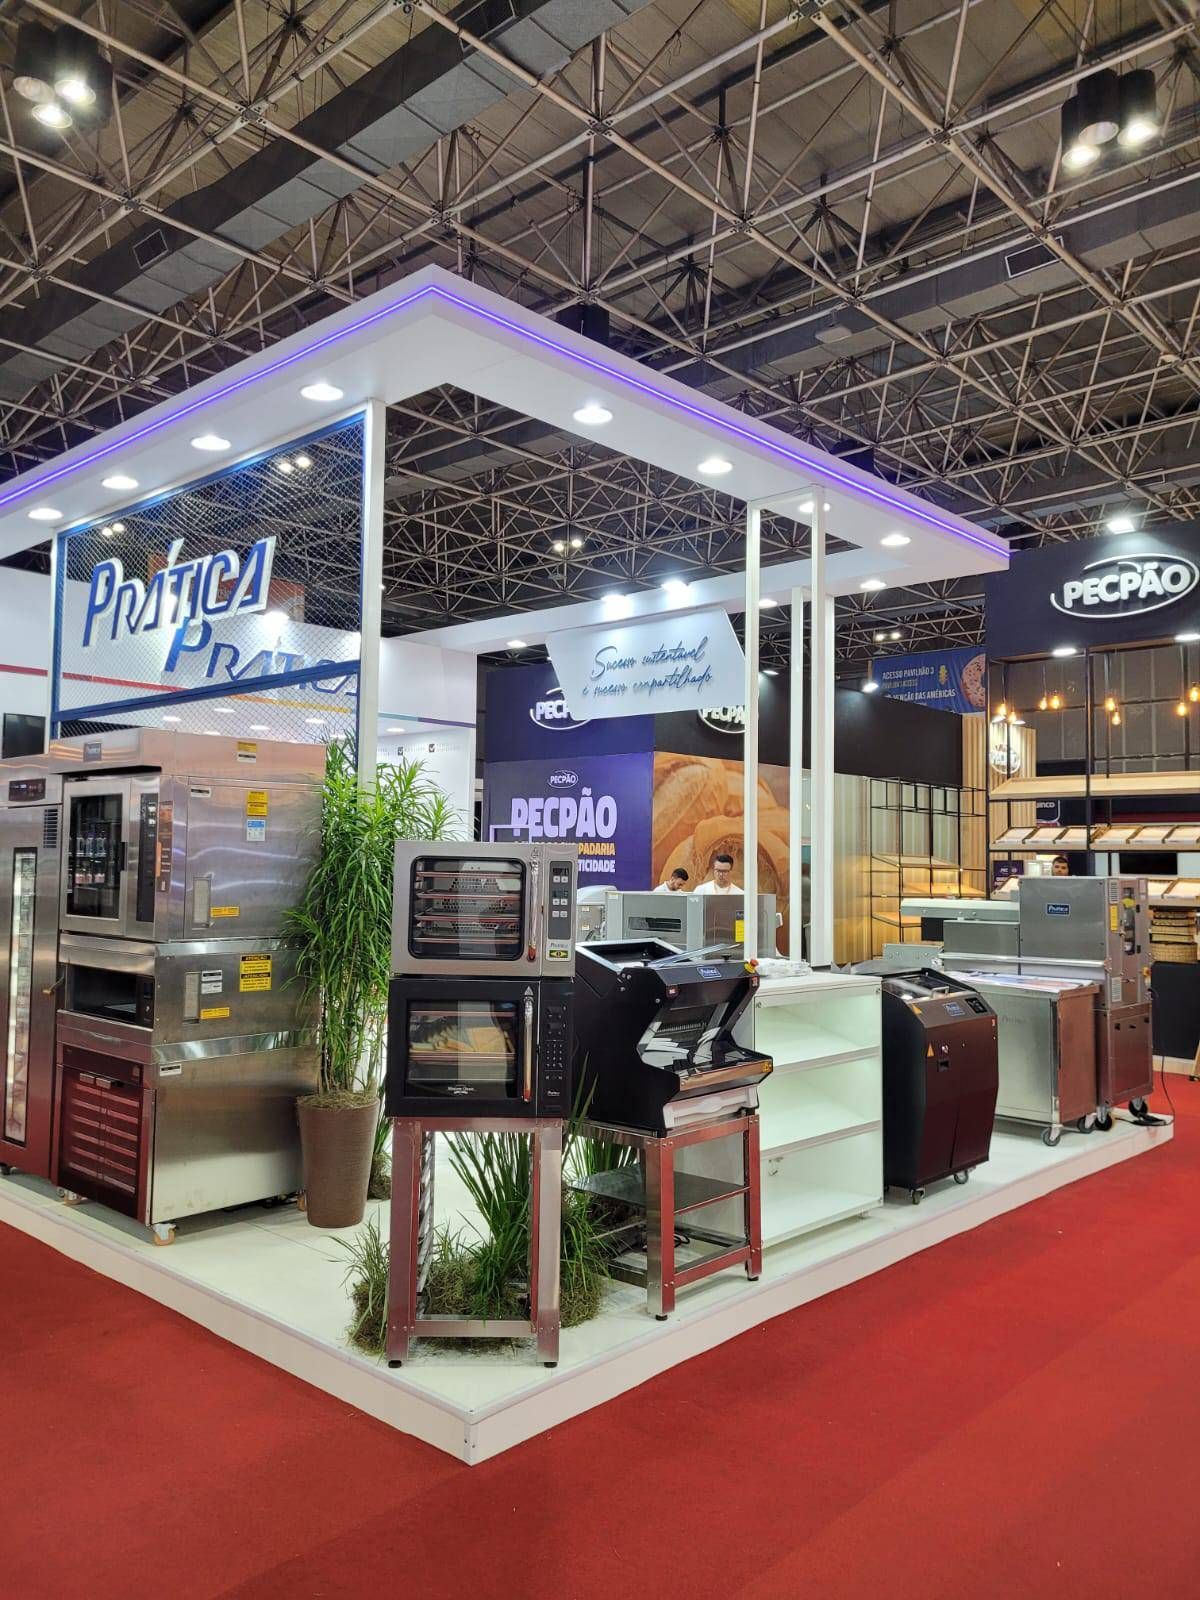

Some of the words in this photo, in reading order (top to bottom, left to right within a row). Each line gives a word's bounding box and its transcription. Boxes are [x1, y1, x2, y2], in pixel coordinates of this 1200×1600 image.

[83, 536, 276, 647] PRÁTICA
[1063, 562, 1191, 608] PECPÃO
[591, 646, 637, 680] Sucesso
[882, 669, 904, 680] ACESSO
[633, 665, 713, 696] compartilhado
[926, 689, 956, 700] AMÉRICAS
[550, 774, 577, 784] PECPÃO
[511, 787, 618, 838] PECPÃO
[578, 843, 616, 855] PADARIA
